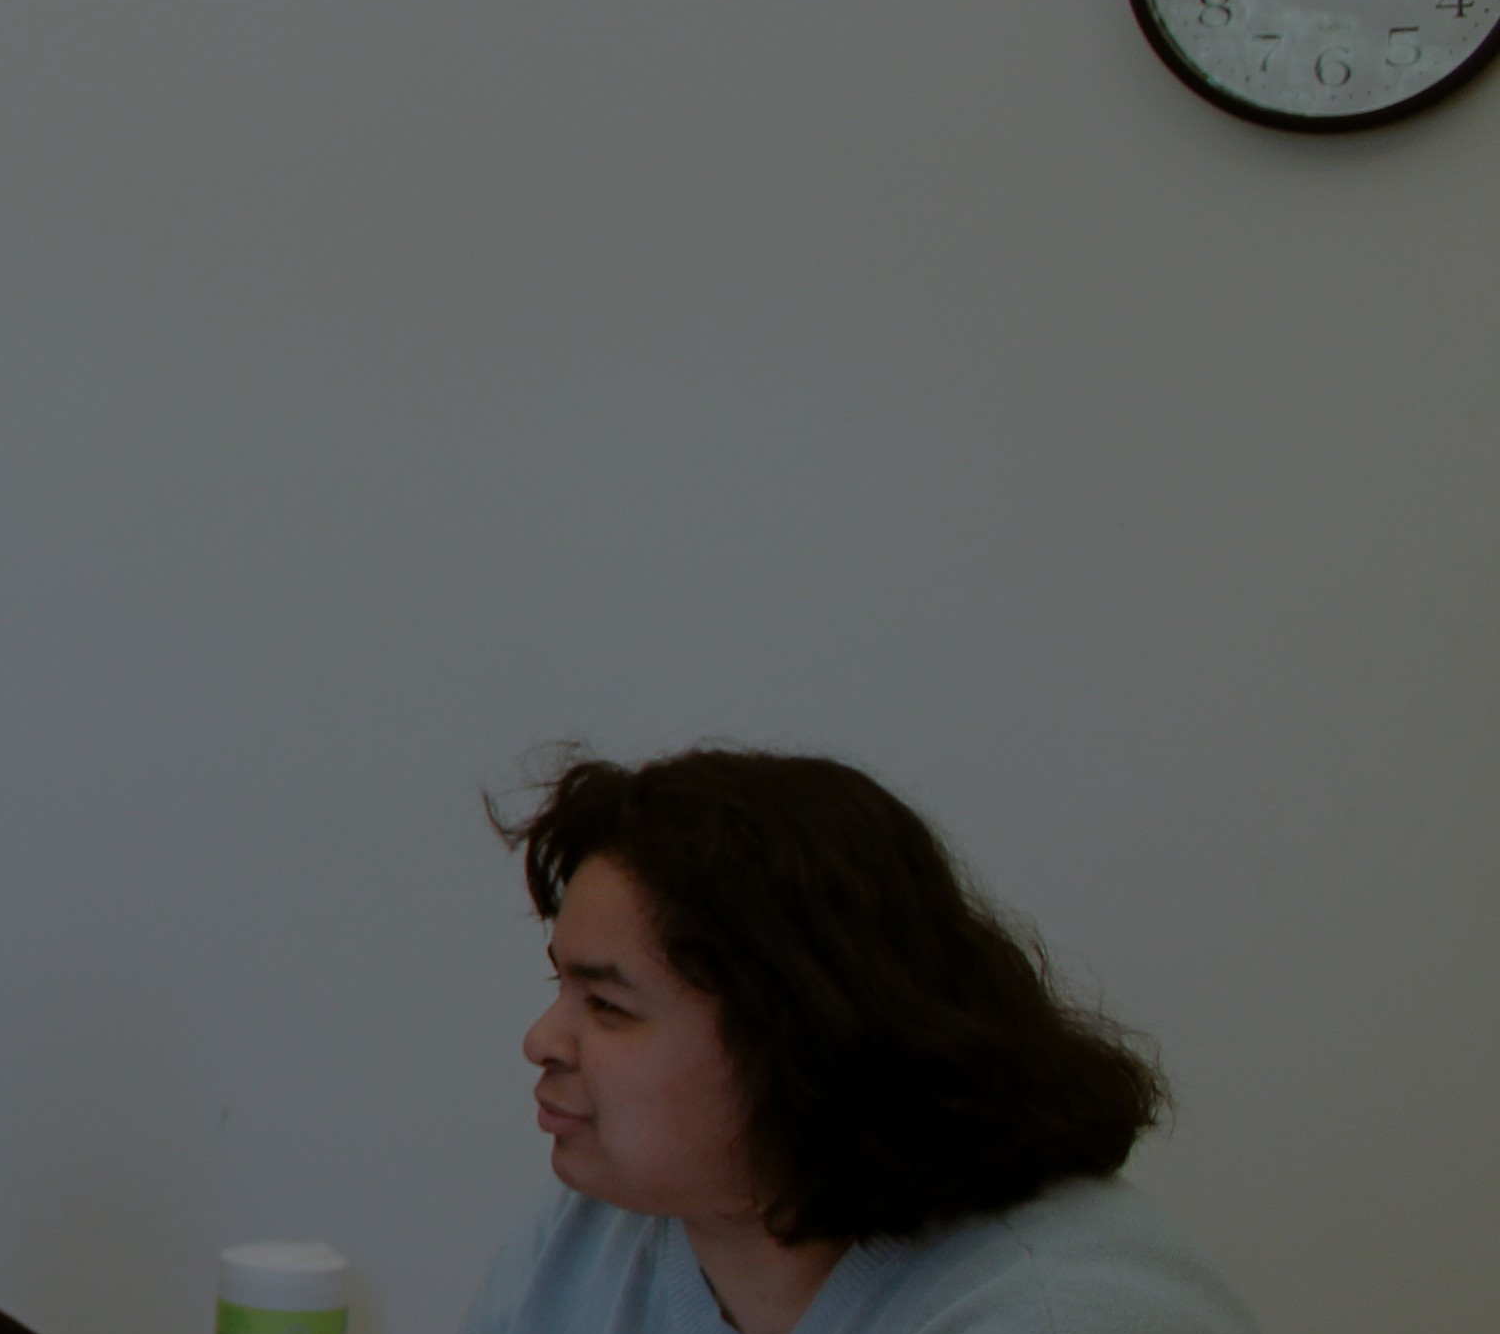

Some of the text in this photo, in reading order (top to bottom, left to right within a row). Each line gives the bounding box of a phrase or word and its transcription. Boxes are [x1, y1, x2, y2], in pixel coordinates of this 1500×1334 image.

[1253, 33, 1282, 71] 7
[1315, 45, 1351, 87] 6
[1385, 26, 1421, 67] 5
